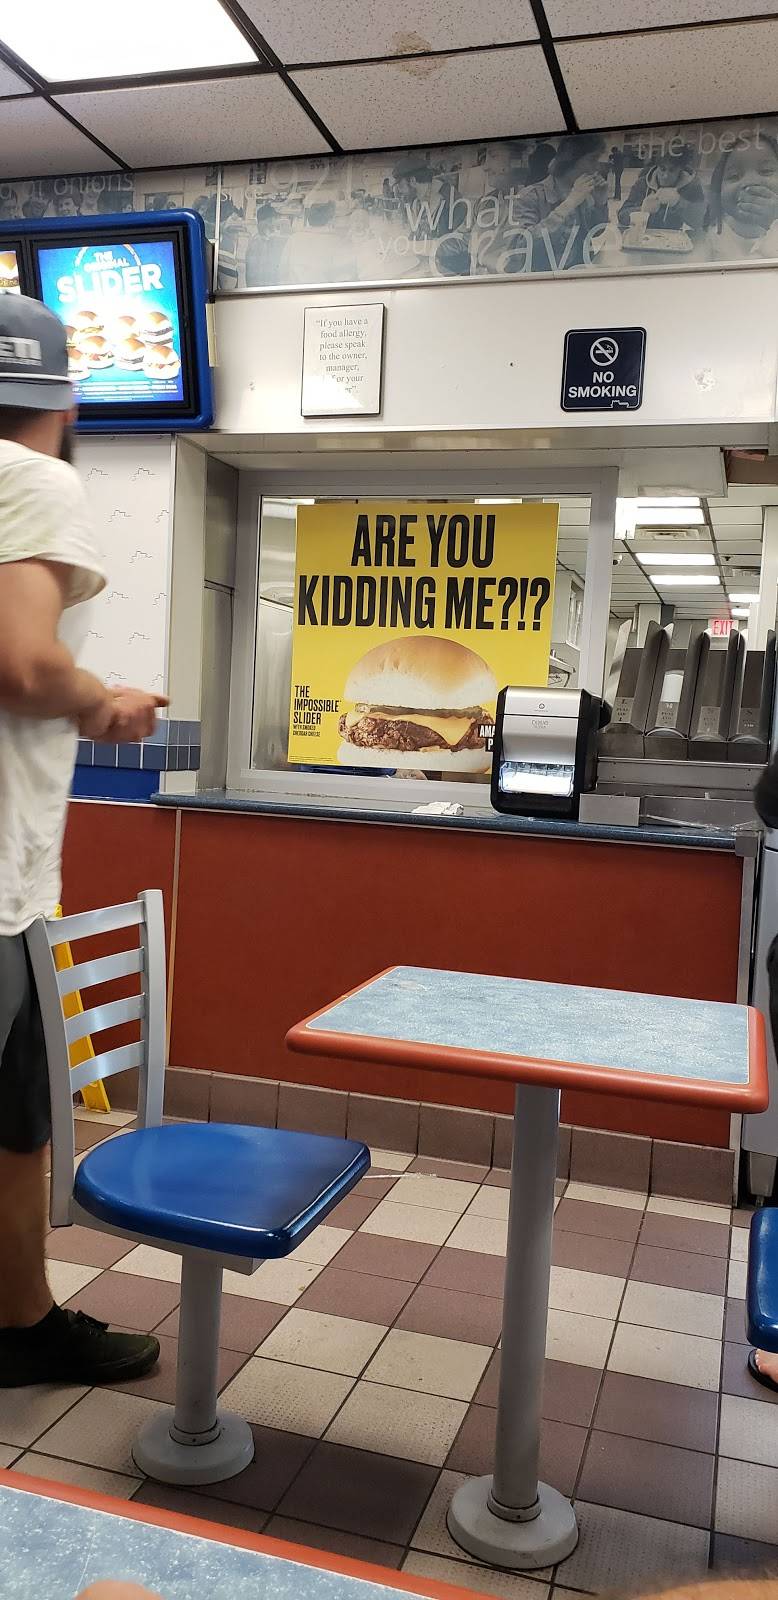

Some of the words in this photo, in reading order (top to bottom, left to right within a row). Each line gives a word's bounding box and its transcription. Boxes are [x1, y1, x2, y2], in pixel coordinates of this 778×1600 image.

[636, 129, 685, 160] the
[697, 122, 765, 155] best
[53, 173, 134, 196] onions
[403, 185, 521, 232] what
[378, 233, 429, 264] you
[428, 221, 625, 277] crave
[56, 263, 165, 303] SLIDER
[328, 320, 343, 329] you
[344, 317, 362, 326] have
[320, 330, 338, 339] food
[319, 341, 343, 351] please
[344, 340, 366, 350] speak
[319, 353, 327, 361] to
[328, 352, 341, 361] the
[336, 375, 345, 383] or
[346, 375, 364, 384] your
[592, 370, 615, 384] NO
[567, 385, 637, 398] SMOKING
[350, 514, 418, 568] ARE
[426, 514, 496, 569] YOU
[297, 575, 437, 629] KIDDING
[444, 576, 551, 631] ME?!?
[713, 620, 735, 636] EXIT
[294, 685, 310, 698] THE
[294, 699, 339, 712] IMPOSSIBLE
[293, 711, 322, 725] SLIDER
